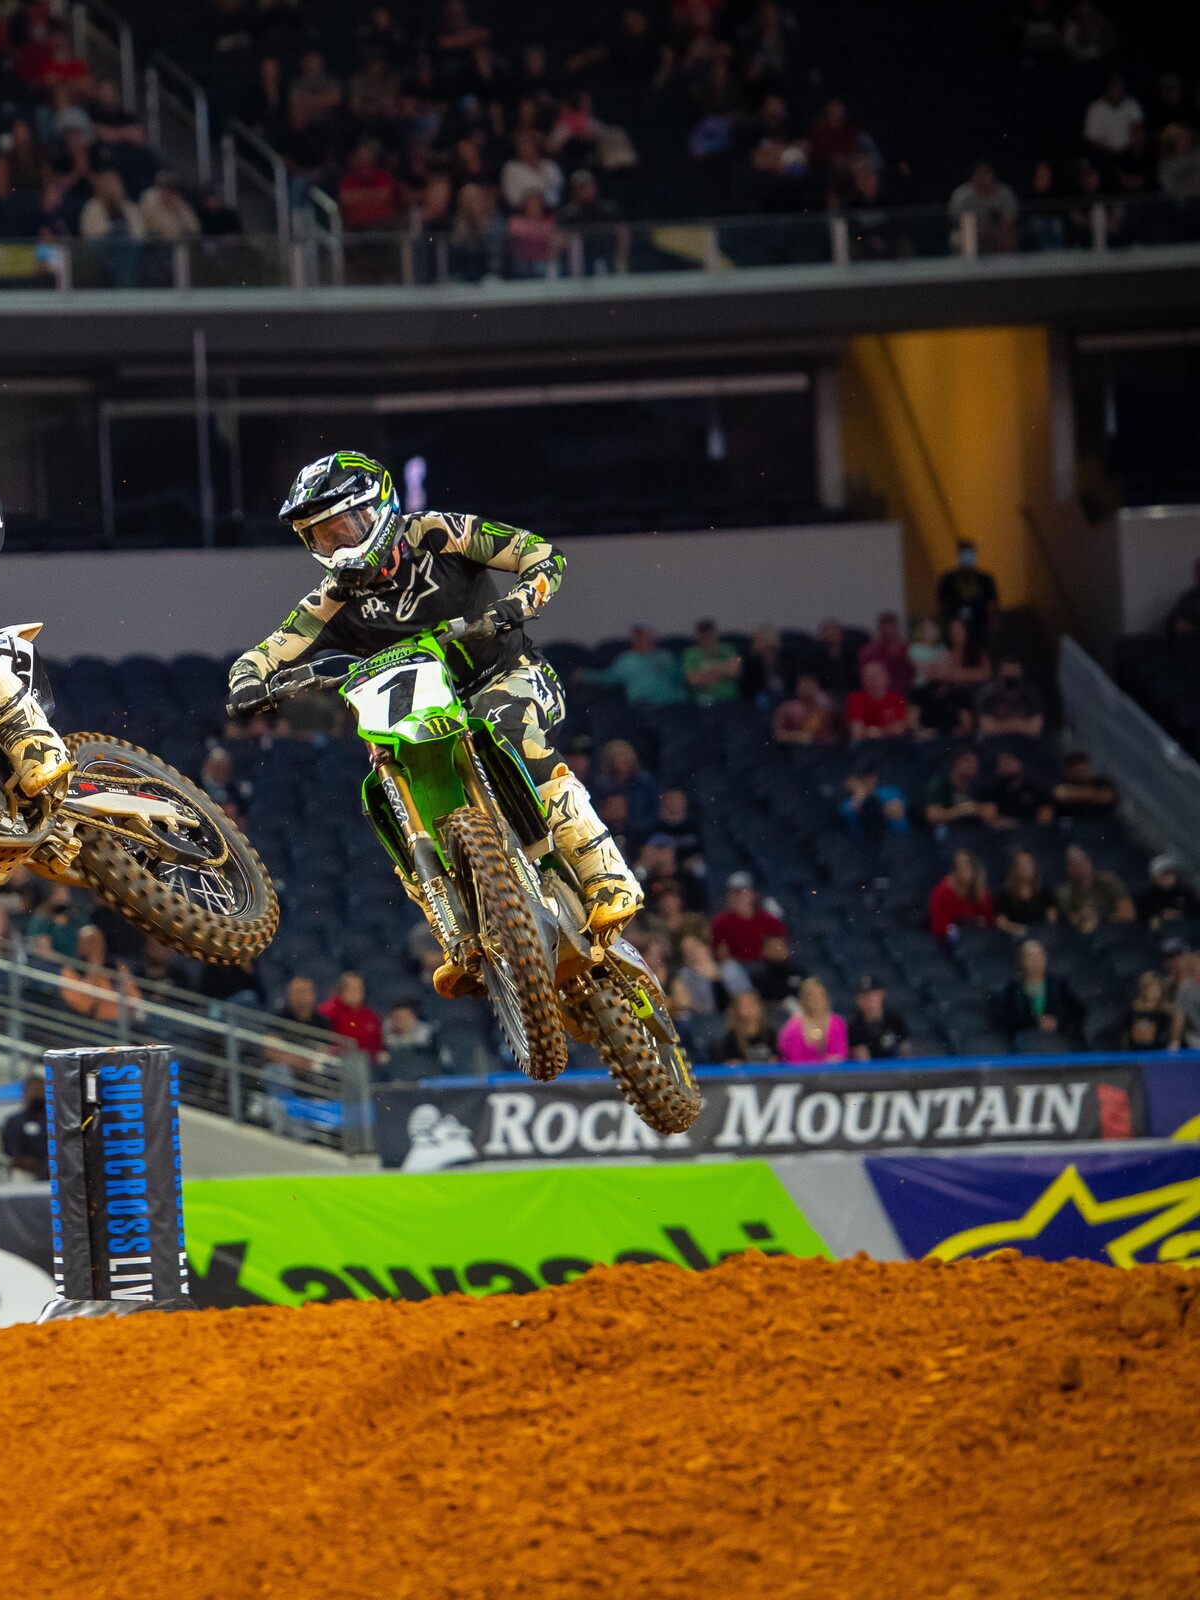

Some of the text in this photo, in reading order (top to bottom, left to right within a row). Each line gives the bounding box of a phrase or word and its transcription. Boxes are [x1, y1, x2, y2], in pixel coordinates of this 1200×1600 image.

[373, 512, 398, 552] MONSTER
[377, 668, 418, 728] 1
[421, 881, 451, 943] DUNLOP
[442, 898, 461, 936] CARRILLO
[484, 1092, 694, 1155] ROCK
[101, 1064, 151, 1253] SUPERCROSS
[186, 1222, 792, 1312] Kawa
